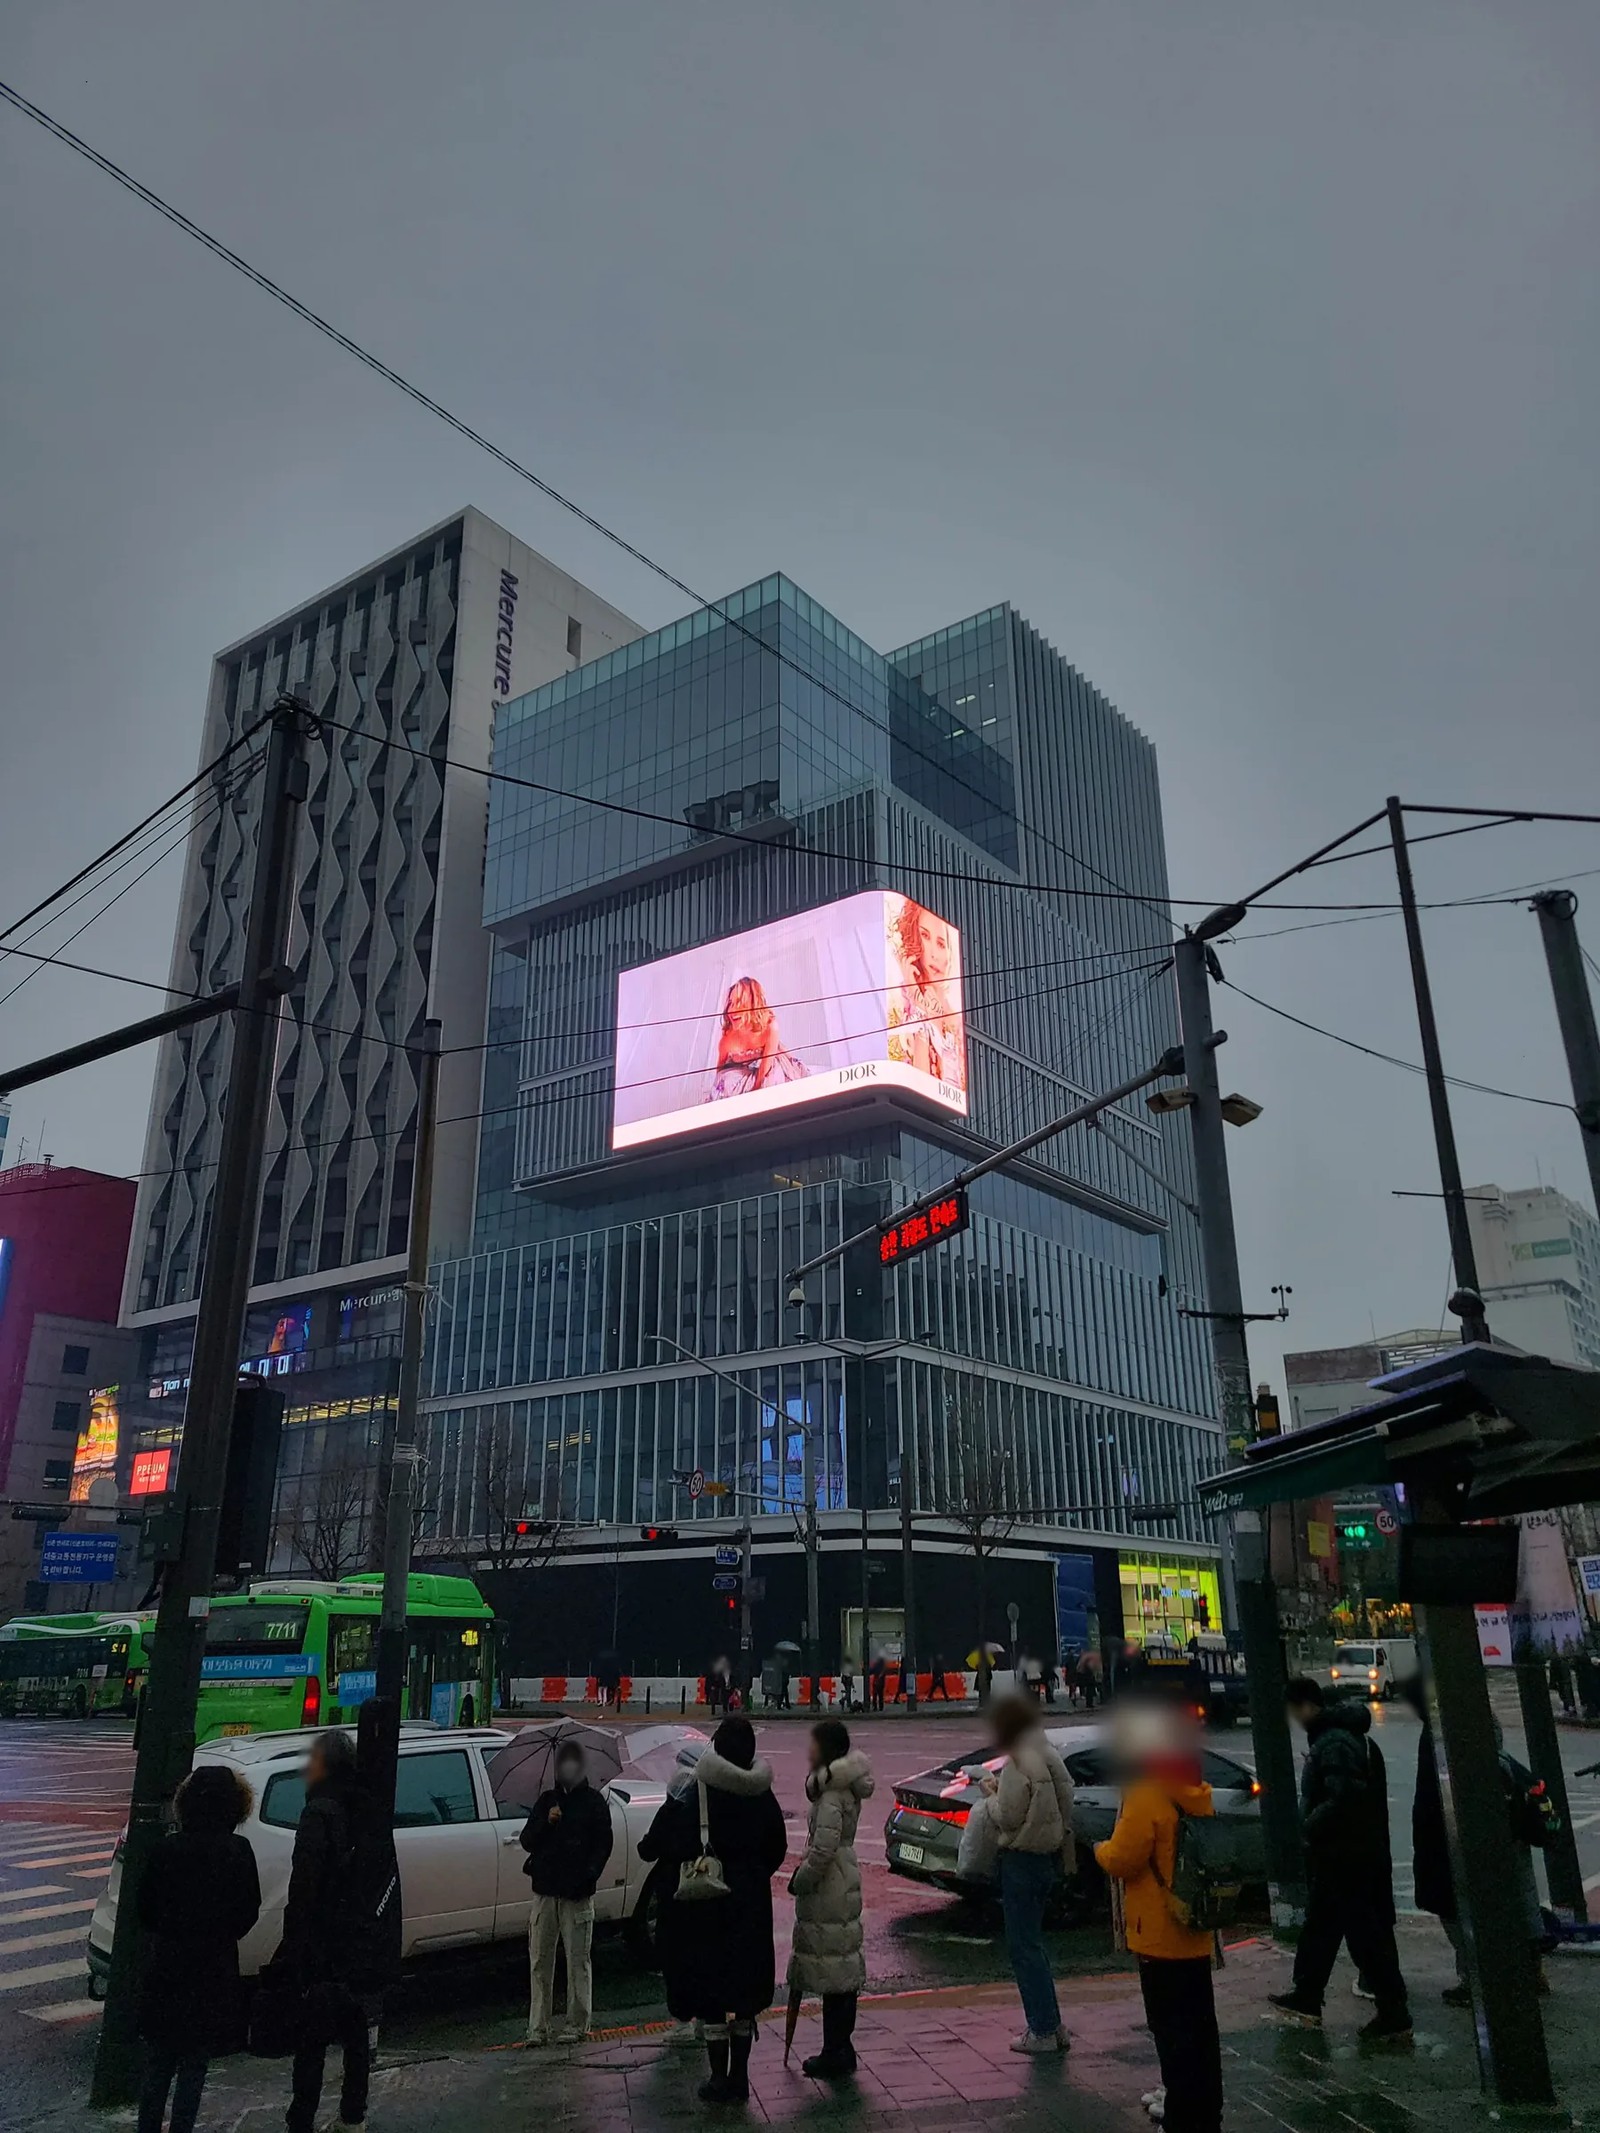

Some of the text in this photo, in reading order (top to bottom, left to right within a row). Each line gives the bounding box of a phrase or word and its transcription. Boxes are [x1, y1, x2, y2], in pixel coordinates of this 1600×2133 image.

[494, 568, 519, 696] Mercure
[839, 1064, 877, 1084] DIOR
[938, 1082, 962, 1105] DIOR
[1380, 1516, 1394, 1528] 50
[266, 1622, 297, 1639] 7711
[376, 1876, 397, 1917] mono
